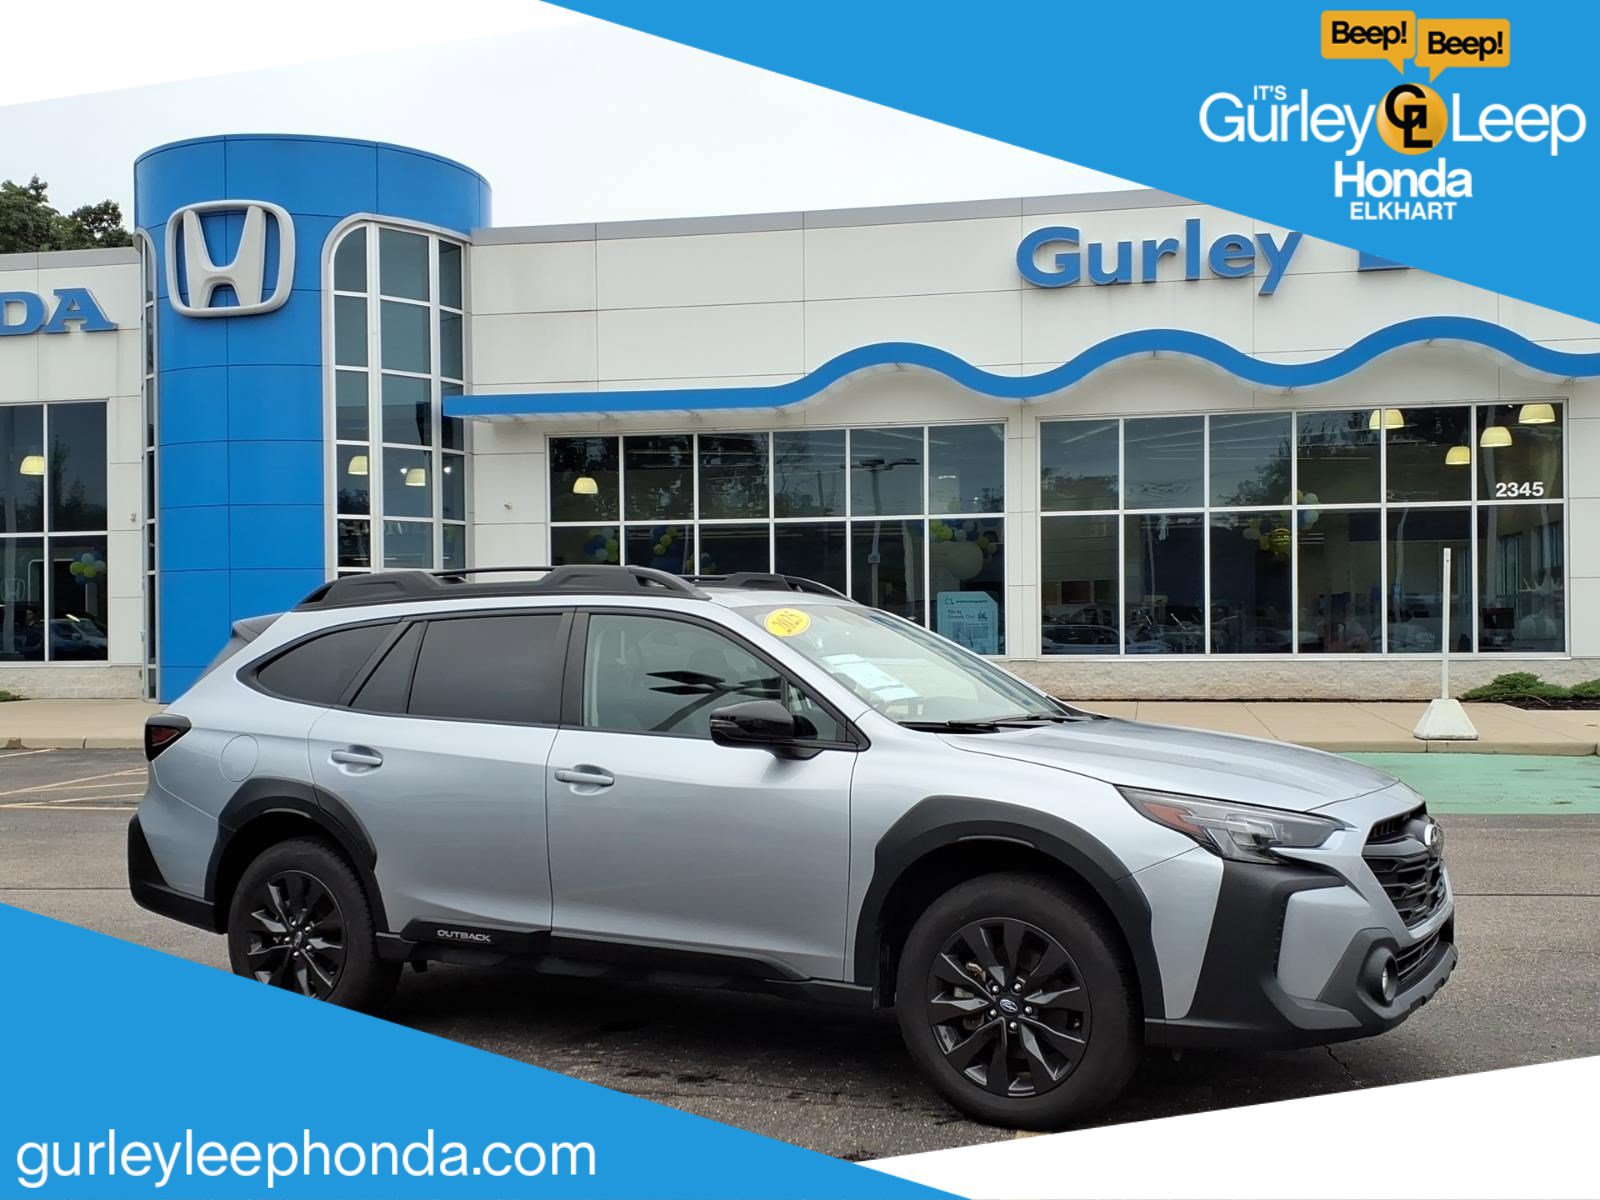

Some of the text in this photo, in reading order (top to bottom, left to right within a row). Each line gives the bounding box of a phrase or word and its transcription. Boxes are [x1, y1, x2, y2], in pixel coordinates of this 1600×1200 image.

[1016, 218, 1303, 297] Gurley
[1495, 481, 1544, 498] 2345
[436, 929, 492, 943] OUTBACK
